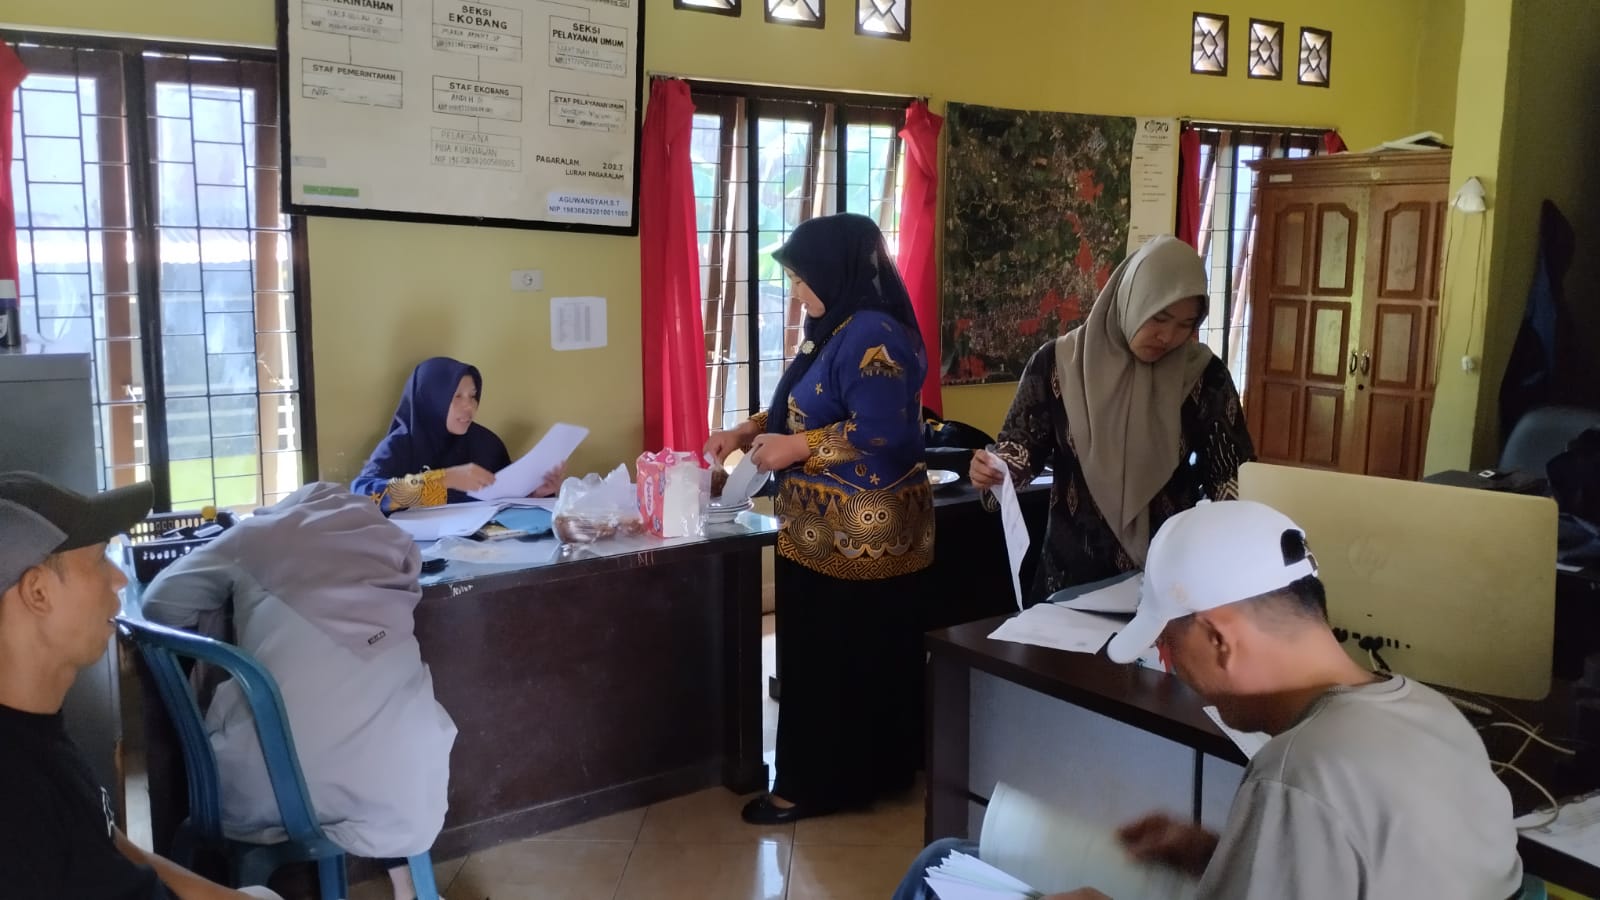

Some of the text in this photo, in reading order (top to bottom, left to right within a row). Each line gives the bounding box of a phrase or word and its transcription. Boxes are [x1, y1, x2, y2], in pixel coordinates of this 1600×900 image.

[462, 5, 492, 17] SEKSI
[448, 13, 508, 30] EKOBANG
[572, 22, 601, 35] SEKSI
[552, 29, 624, 48] PELAYANAN UMUM
[312, 64, 396, 81] STAF PEMERINTAHAN
[449, 82, 509, 97] STAF EKOBANG
[554, 95, 572, 104] STAF
[536, 154, 580, 167] PAGARALAM
[565, 168, 624, 181] LURAH PAGARALAM
